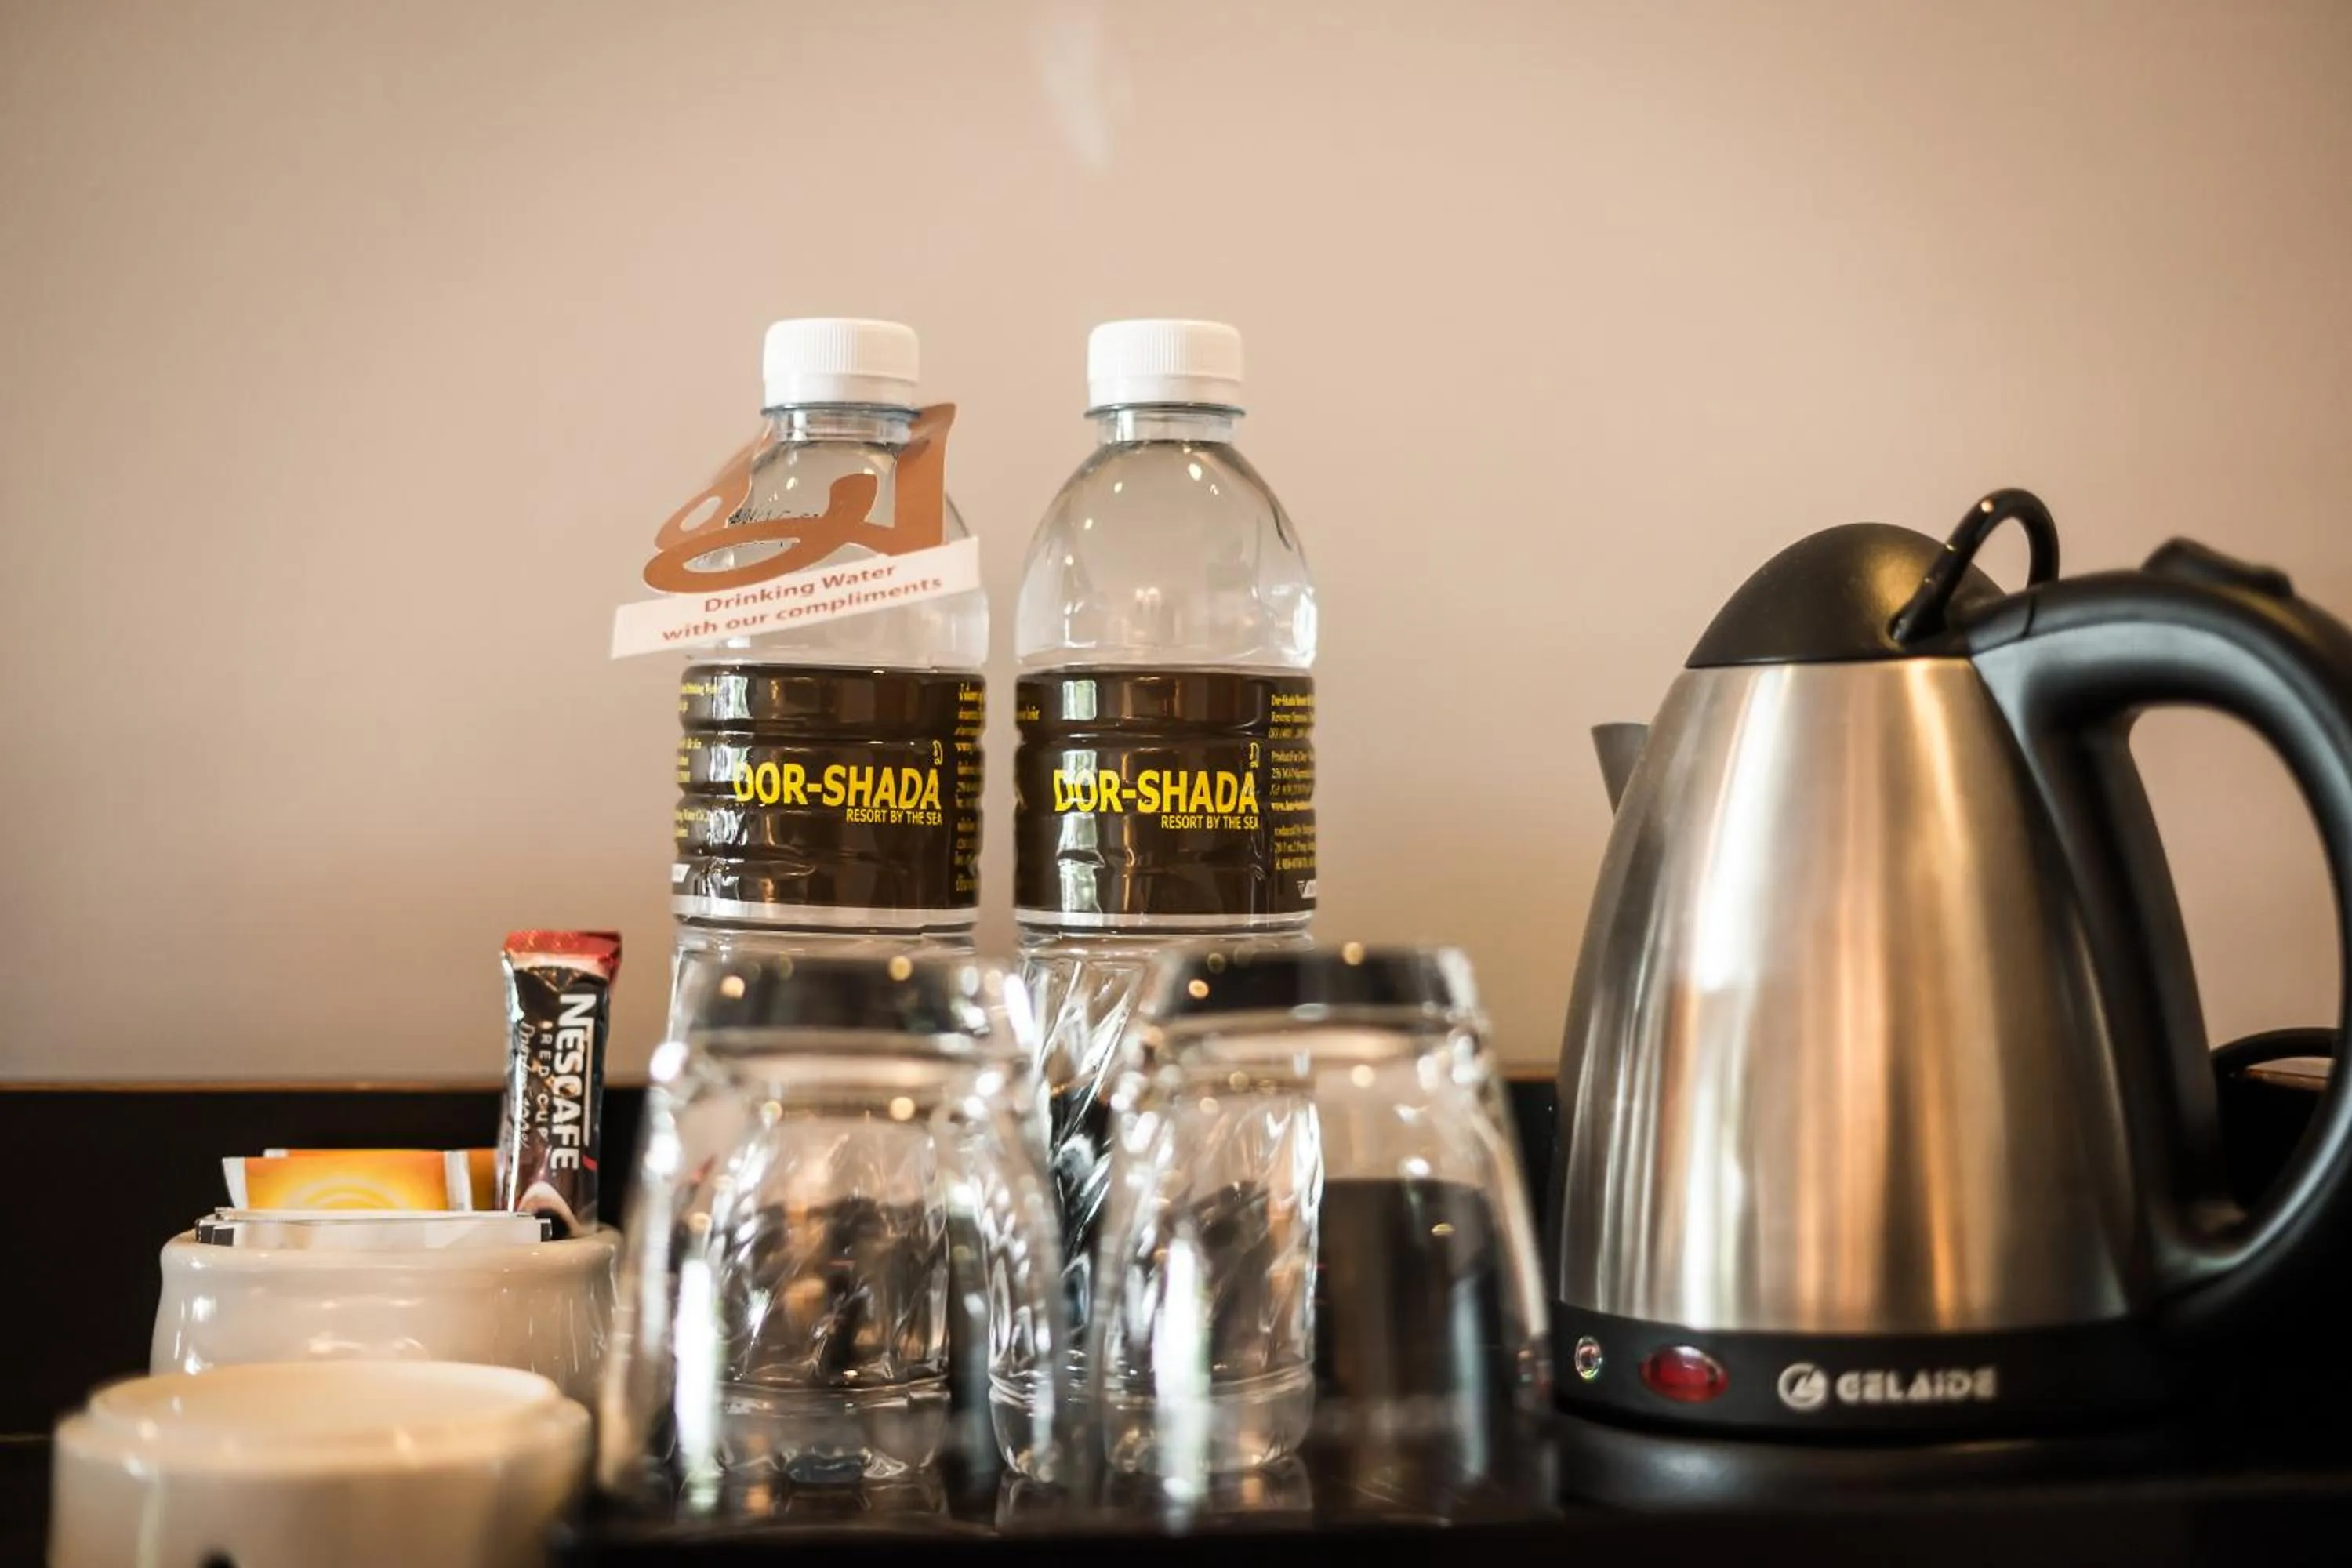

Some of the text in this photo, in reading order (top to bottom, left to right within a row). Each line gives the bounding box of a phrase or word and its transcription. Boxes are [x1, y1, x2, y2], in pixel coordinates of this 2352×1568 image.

[662, 576, 943, 641] with our compliments
[704, 564, 896, 612] Drinking Water
[732, 761, 942, 810] DOR-SHADA
[1053, 769, 1259, 814] DOR-SHADA
[846, 808, 887, 823] RESORT
[890, 809, 904, 824] BY
[906, 811, 924, 825] THE
[926, 811, 942, 826] SEA
[1161, 815, 1259, 829] RESORT BY THE SEA
[535, 1033, 554, 1142] RED CUP
